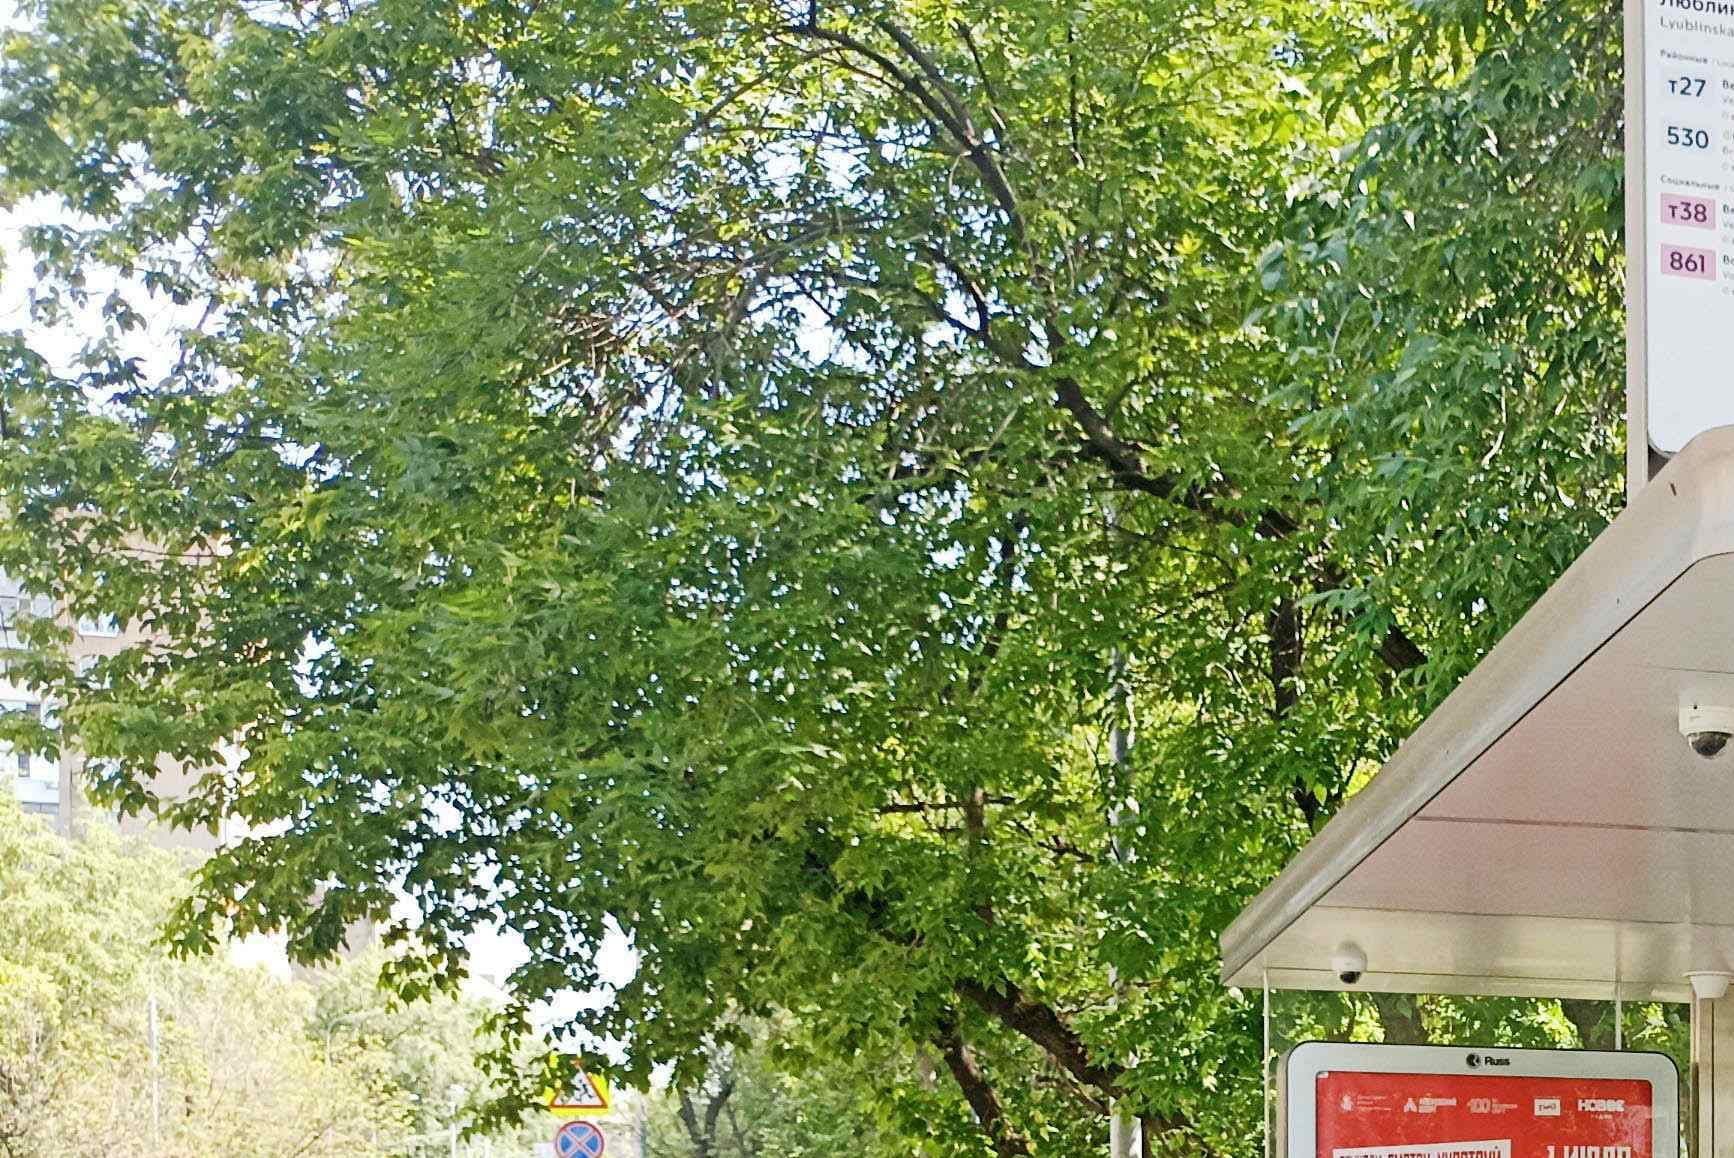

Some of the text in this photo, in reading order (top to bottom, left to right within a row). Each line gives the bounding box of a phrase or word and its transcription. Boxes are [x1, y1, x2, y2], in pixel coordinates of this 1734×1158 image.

[1667, 125, 1709, 149] 530
[1669, 251, 1706, 274] 861
[1484, 1056, 1511, 1066] Russ
